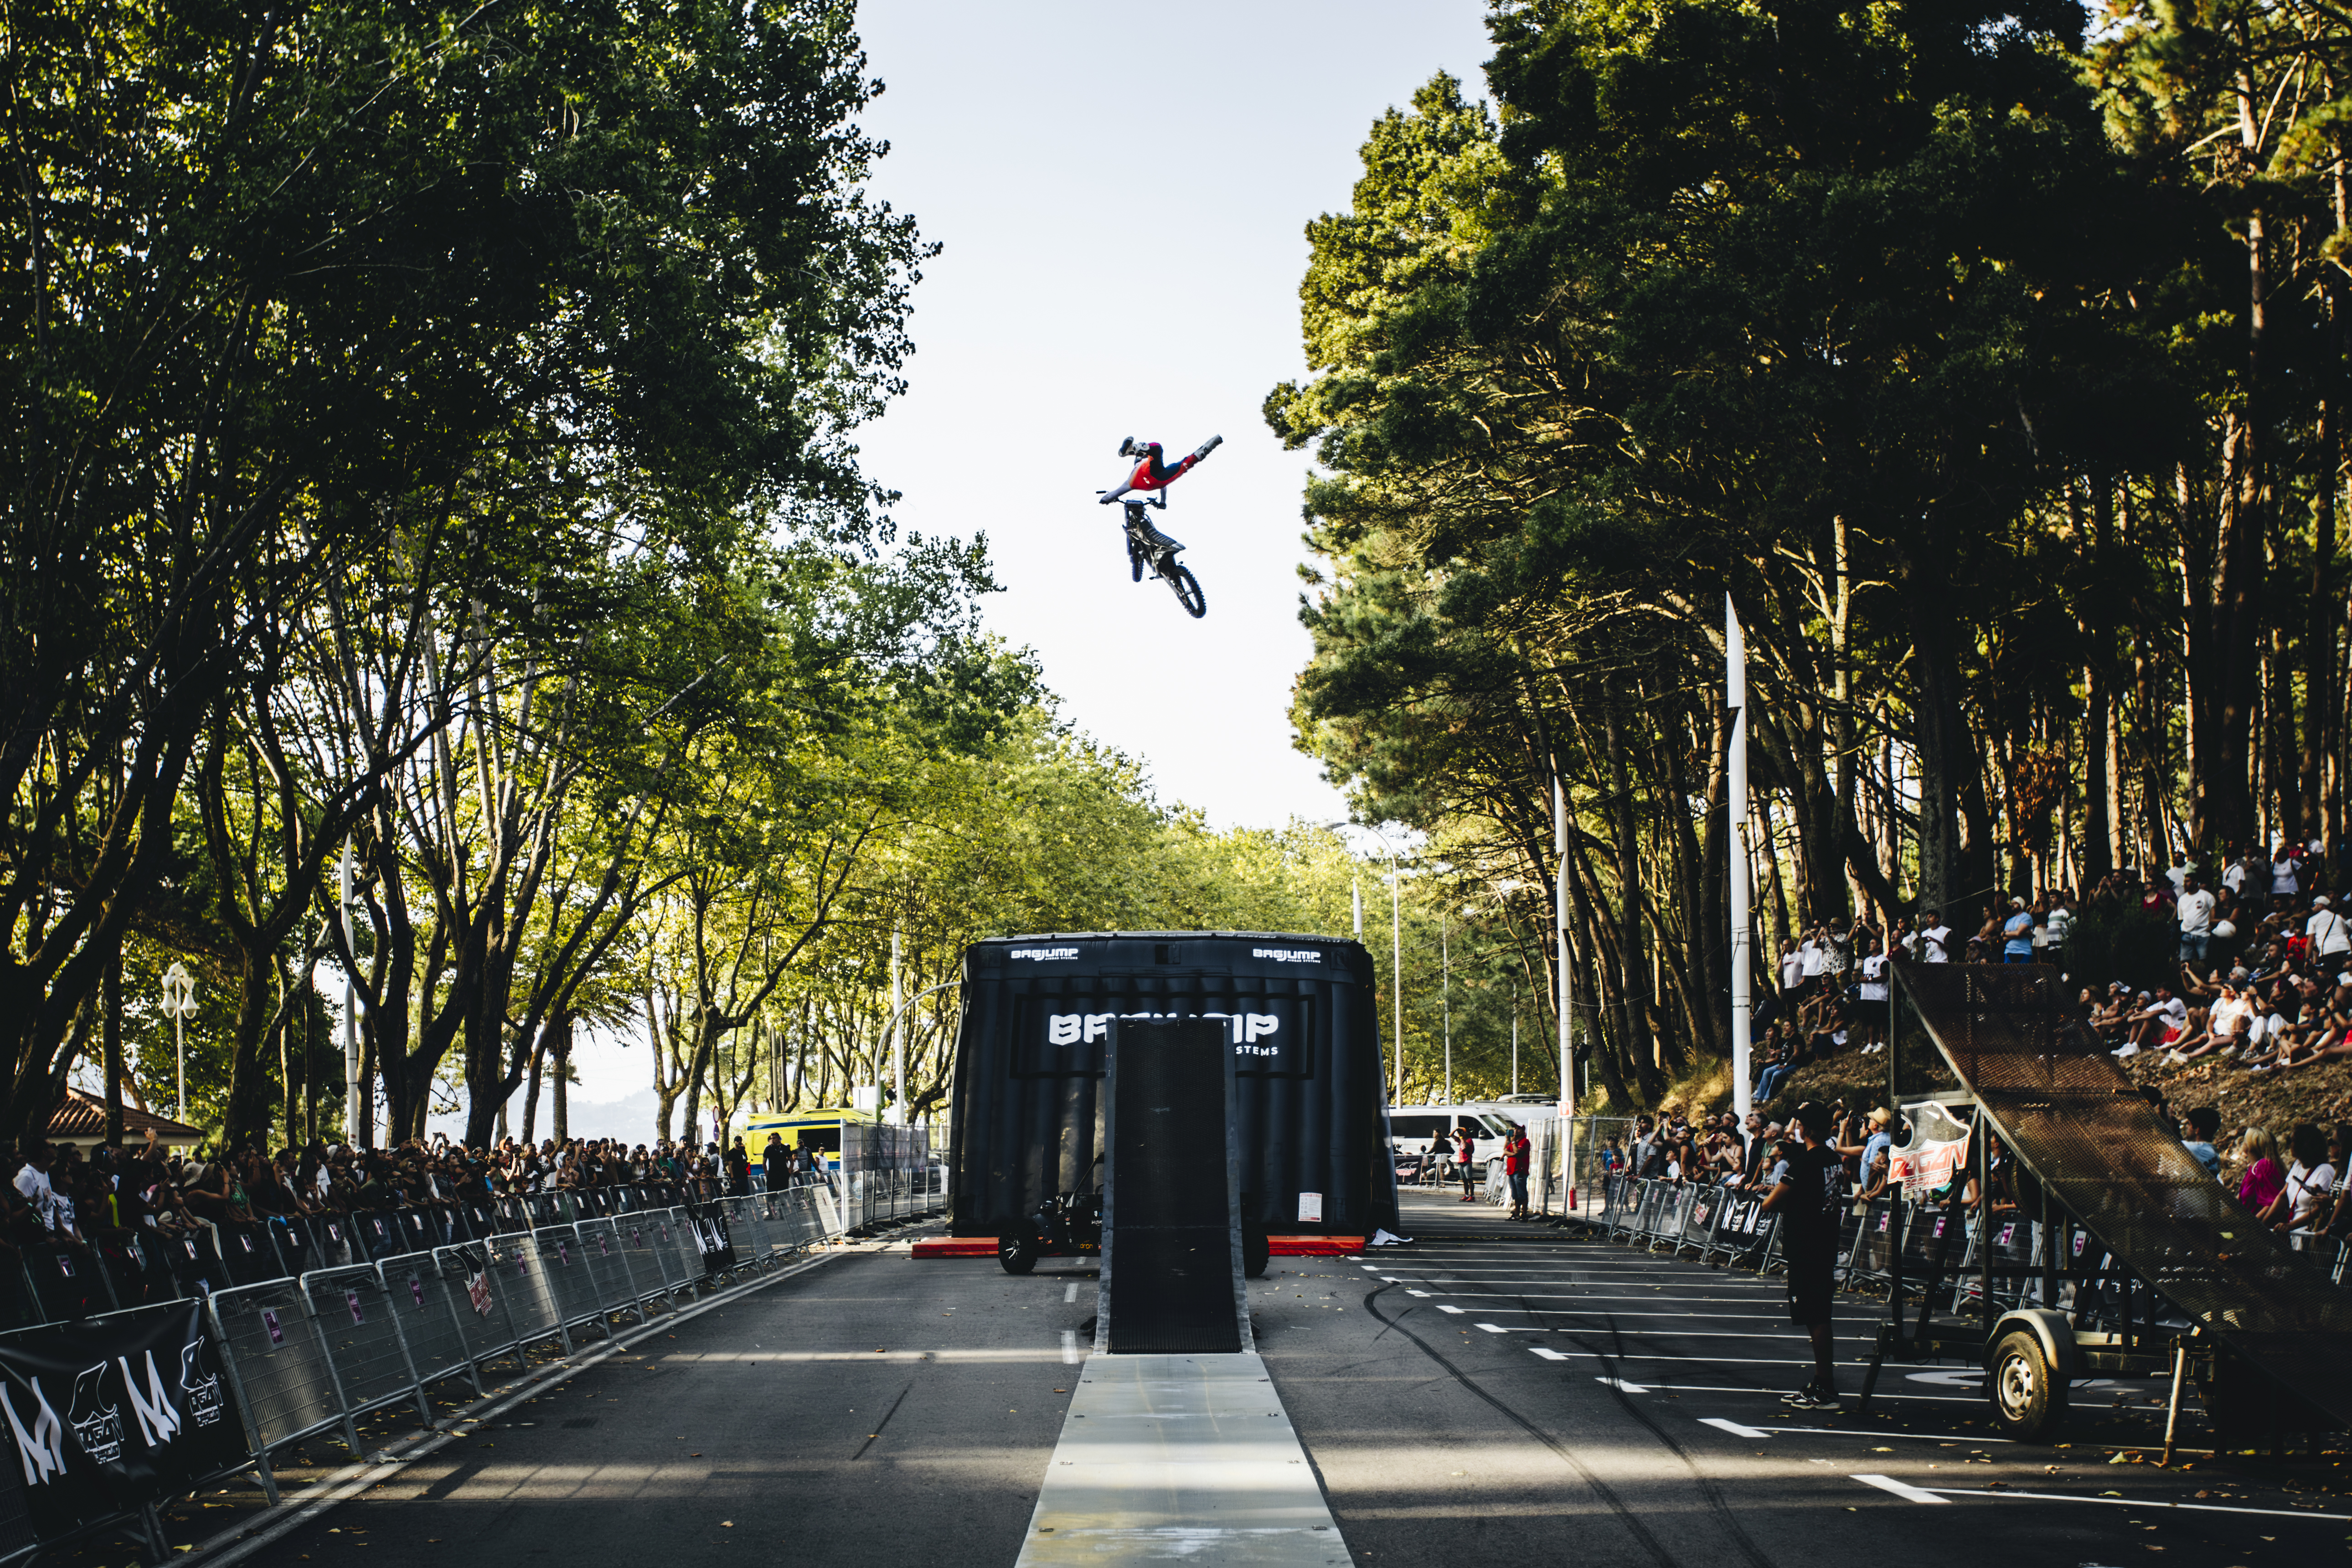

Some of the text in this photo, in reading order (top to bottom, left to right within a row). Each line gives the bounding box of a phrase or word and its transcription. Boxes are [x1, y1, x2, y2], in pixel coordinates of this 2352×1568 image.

[1011, 948, 1078, 961] BAGJUMP
[1253, 948, 1321, 962] BAGJUMP
[1235, 1046, 1278, 1057] STEMS
[1889, 1140, 1967, 1181] DAGAN
[1903, 1171, 1951, 1191] OFFROAD
